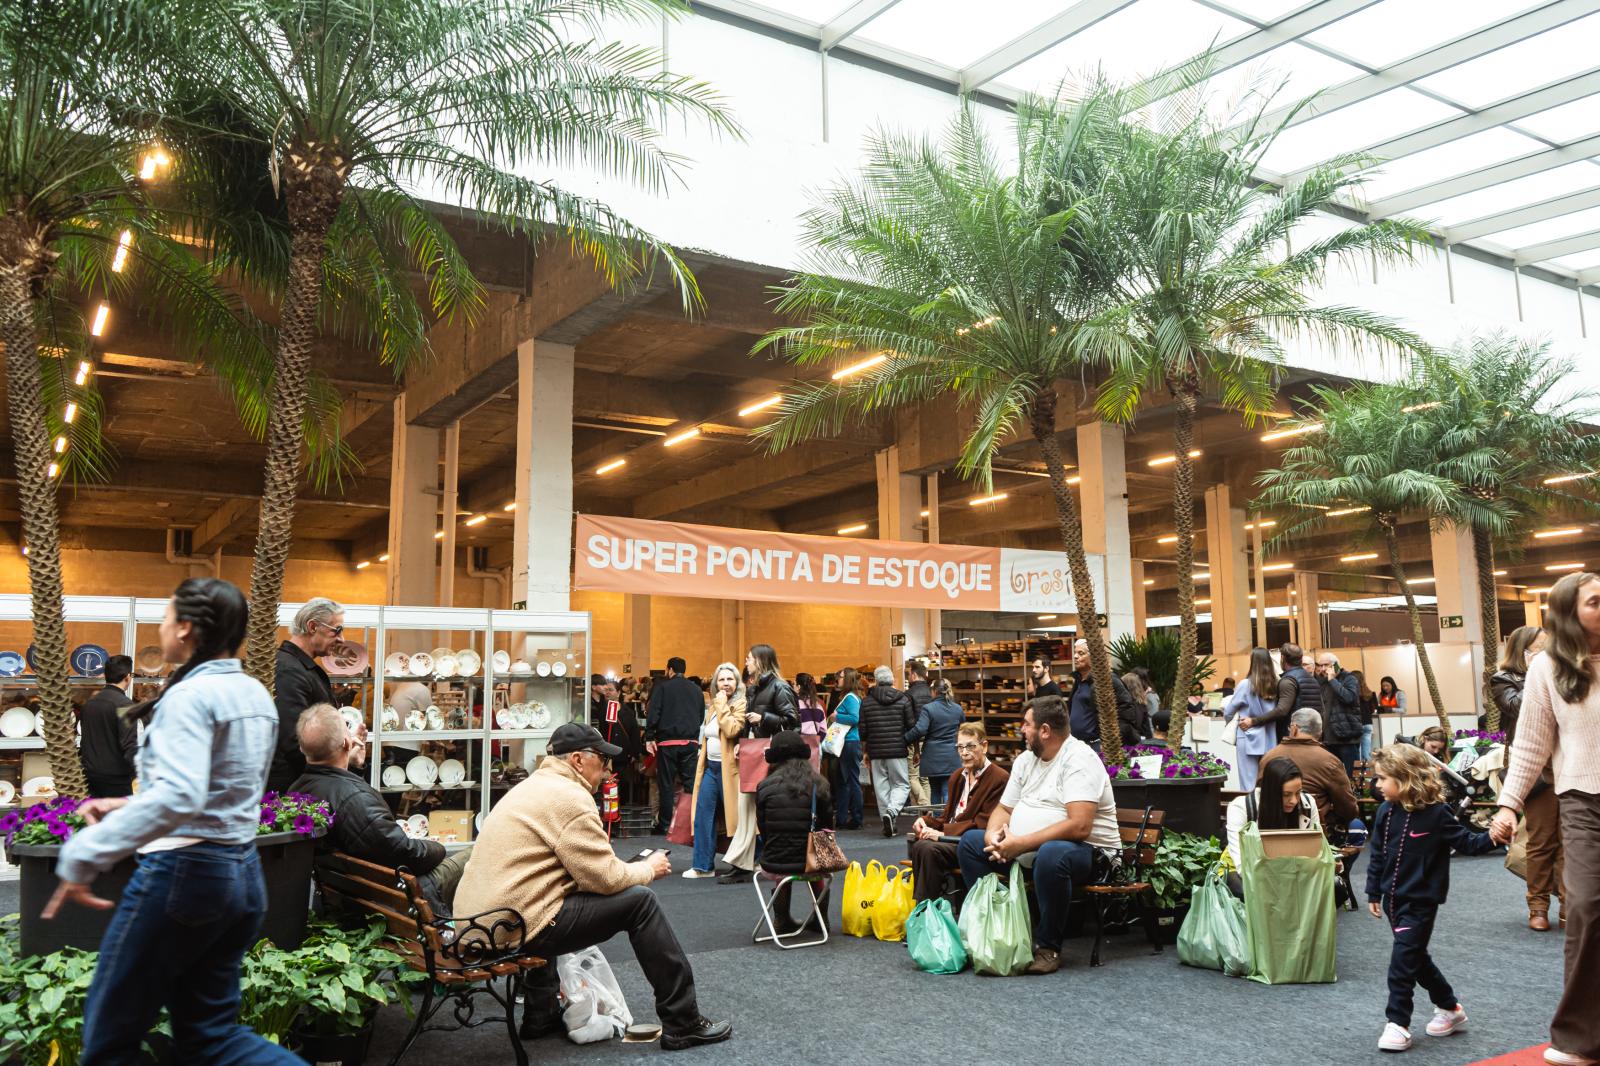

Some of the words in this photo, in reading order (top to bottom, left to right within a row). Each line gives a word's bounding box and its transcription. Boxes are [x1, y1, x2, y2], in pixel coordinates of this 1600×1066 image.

[587, 534, 698, 575] SUPER
[706, 544, 814, 582] PONTA
[822, 553, 861, 585] DE
[867, 556, 992, 598] ESTOQUE
